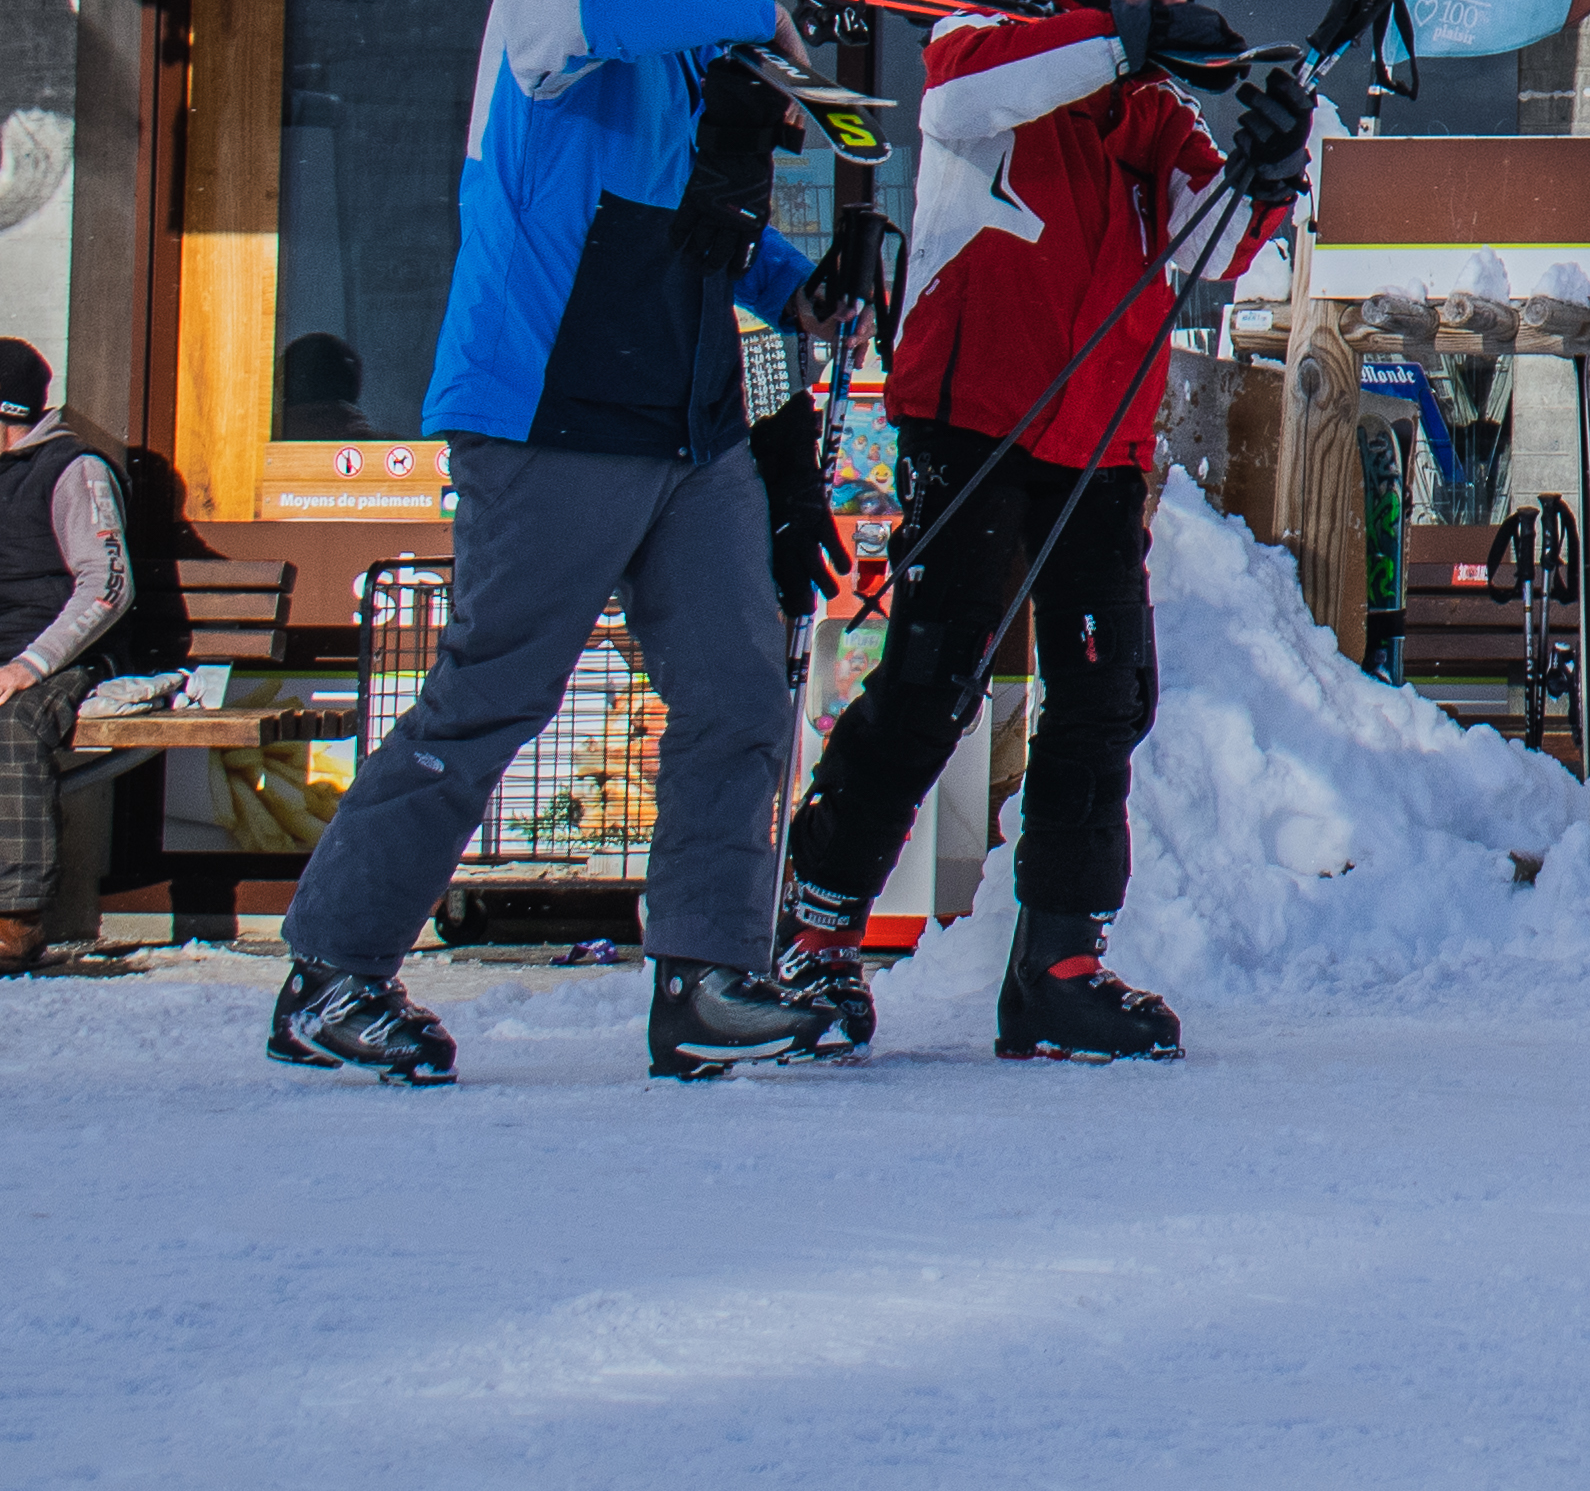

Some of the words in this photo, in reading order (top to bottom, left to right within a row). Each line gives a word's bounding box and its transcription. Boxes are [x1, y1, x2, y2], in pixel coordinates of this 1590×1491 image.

[280, 493, 335, 509] Moyens
[337, 493, 355, 506] de
[357, 494, 432, 509] paiements
